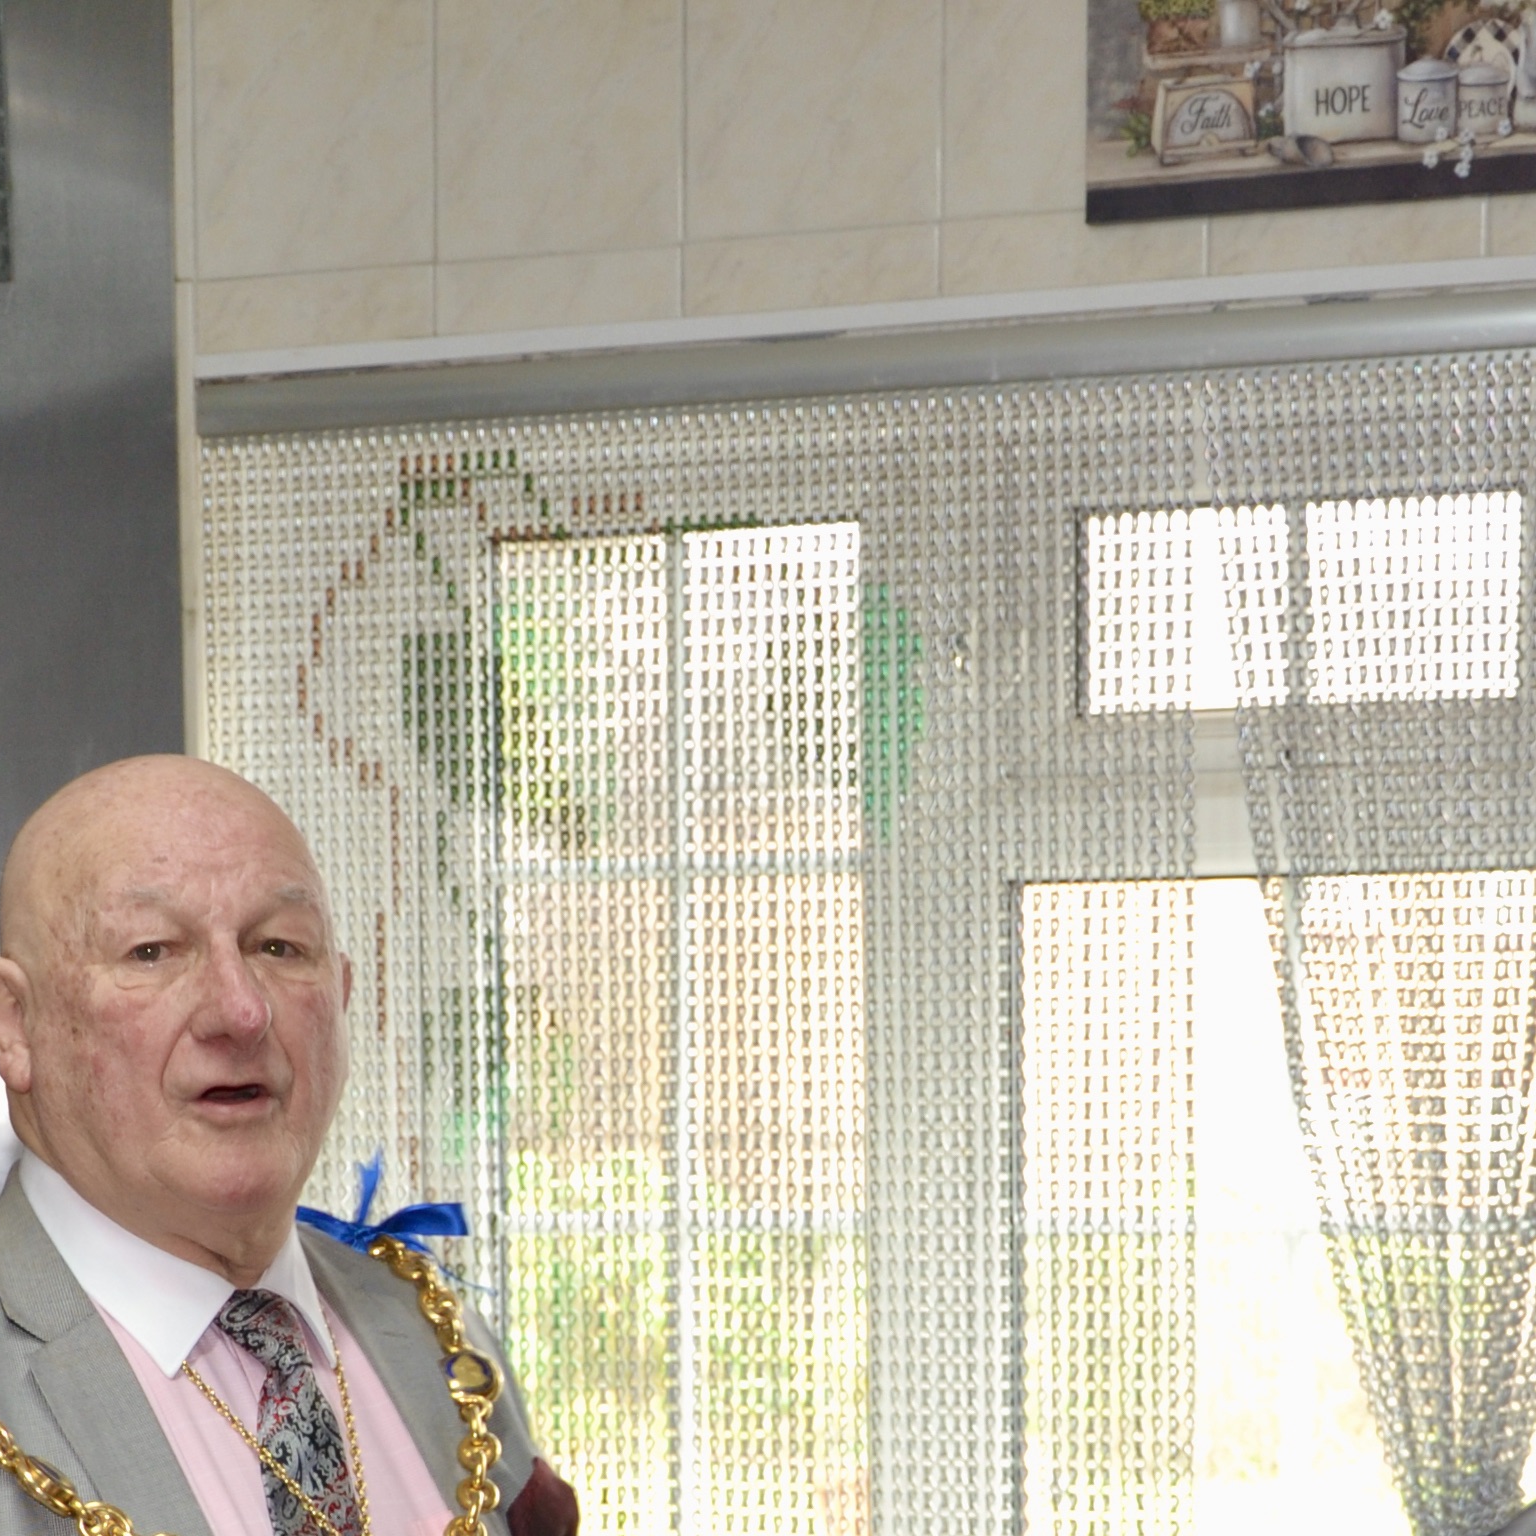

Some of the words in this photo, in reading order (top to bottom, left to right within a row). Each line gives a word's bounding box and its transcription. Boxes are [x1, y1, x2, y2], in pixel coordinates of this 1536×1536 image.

[1180, 91, 1232, 135] Faith
[1315, 85, 1371, 117] HOPE
[1402, 88, 1449, 129] Love
[1461, 97, 1506, 118] PEACE
